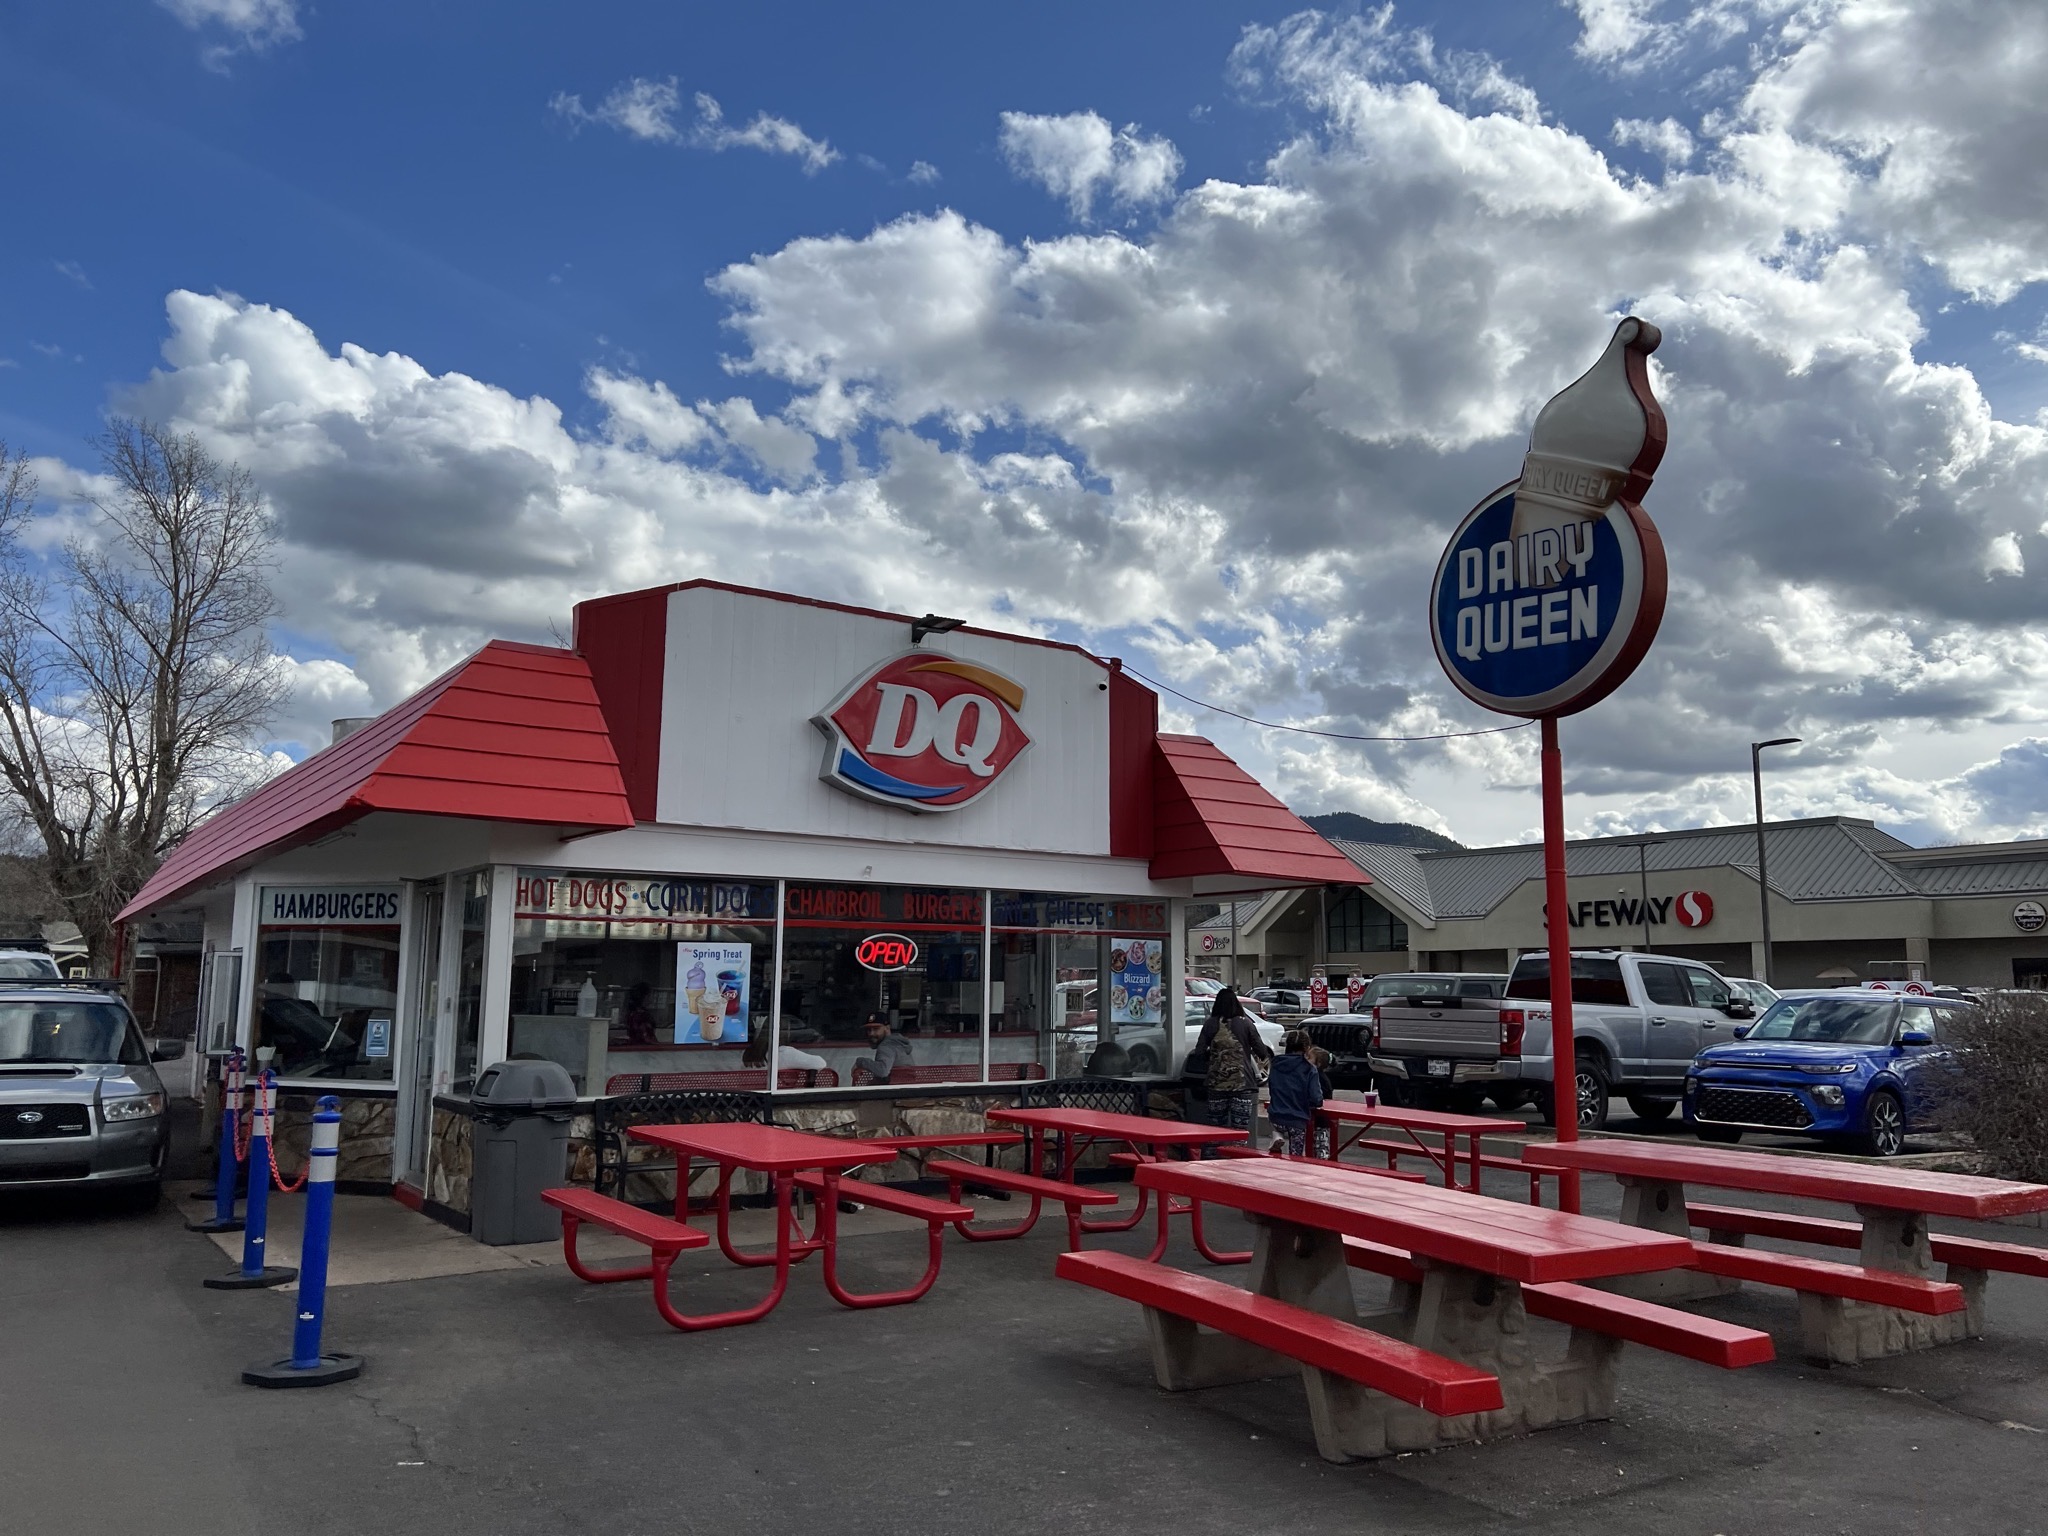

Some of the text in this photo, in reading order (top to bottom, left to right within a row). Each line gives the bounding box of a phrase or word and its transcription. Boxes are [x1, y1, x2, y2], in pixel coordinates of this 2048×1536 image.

[1553, 471, 1612, 501] QUEEN
[1458, 520, 1595, 600] DAIRY
[1456, 584, 1598, 662] QUEEN
[866, 682, 1003, 778] DQ
[274, 892, 399, 919] HAMBURGERS
[516, 877, 628, 911] HOT DOGS
[646, 882, 775, 914] CORN DOGS
[786, 888, 983, 922] CHARBROIL BURGERS
[1045, 900, 1105, 926] CHEESE
[1115, 903, 1166, 929] FRIES
[1542, 896, 1673, 928] FEWAY
[692, 949, 742, 961] Spring Treat
[858, 940, 913, 965] OPEN
[1123, 973, 1151, 984] Blizzard
